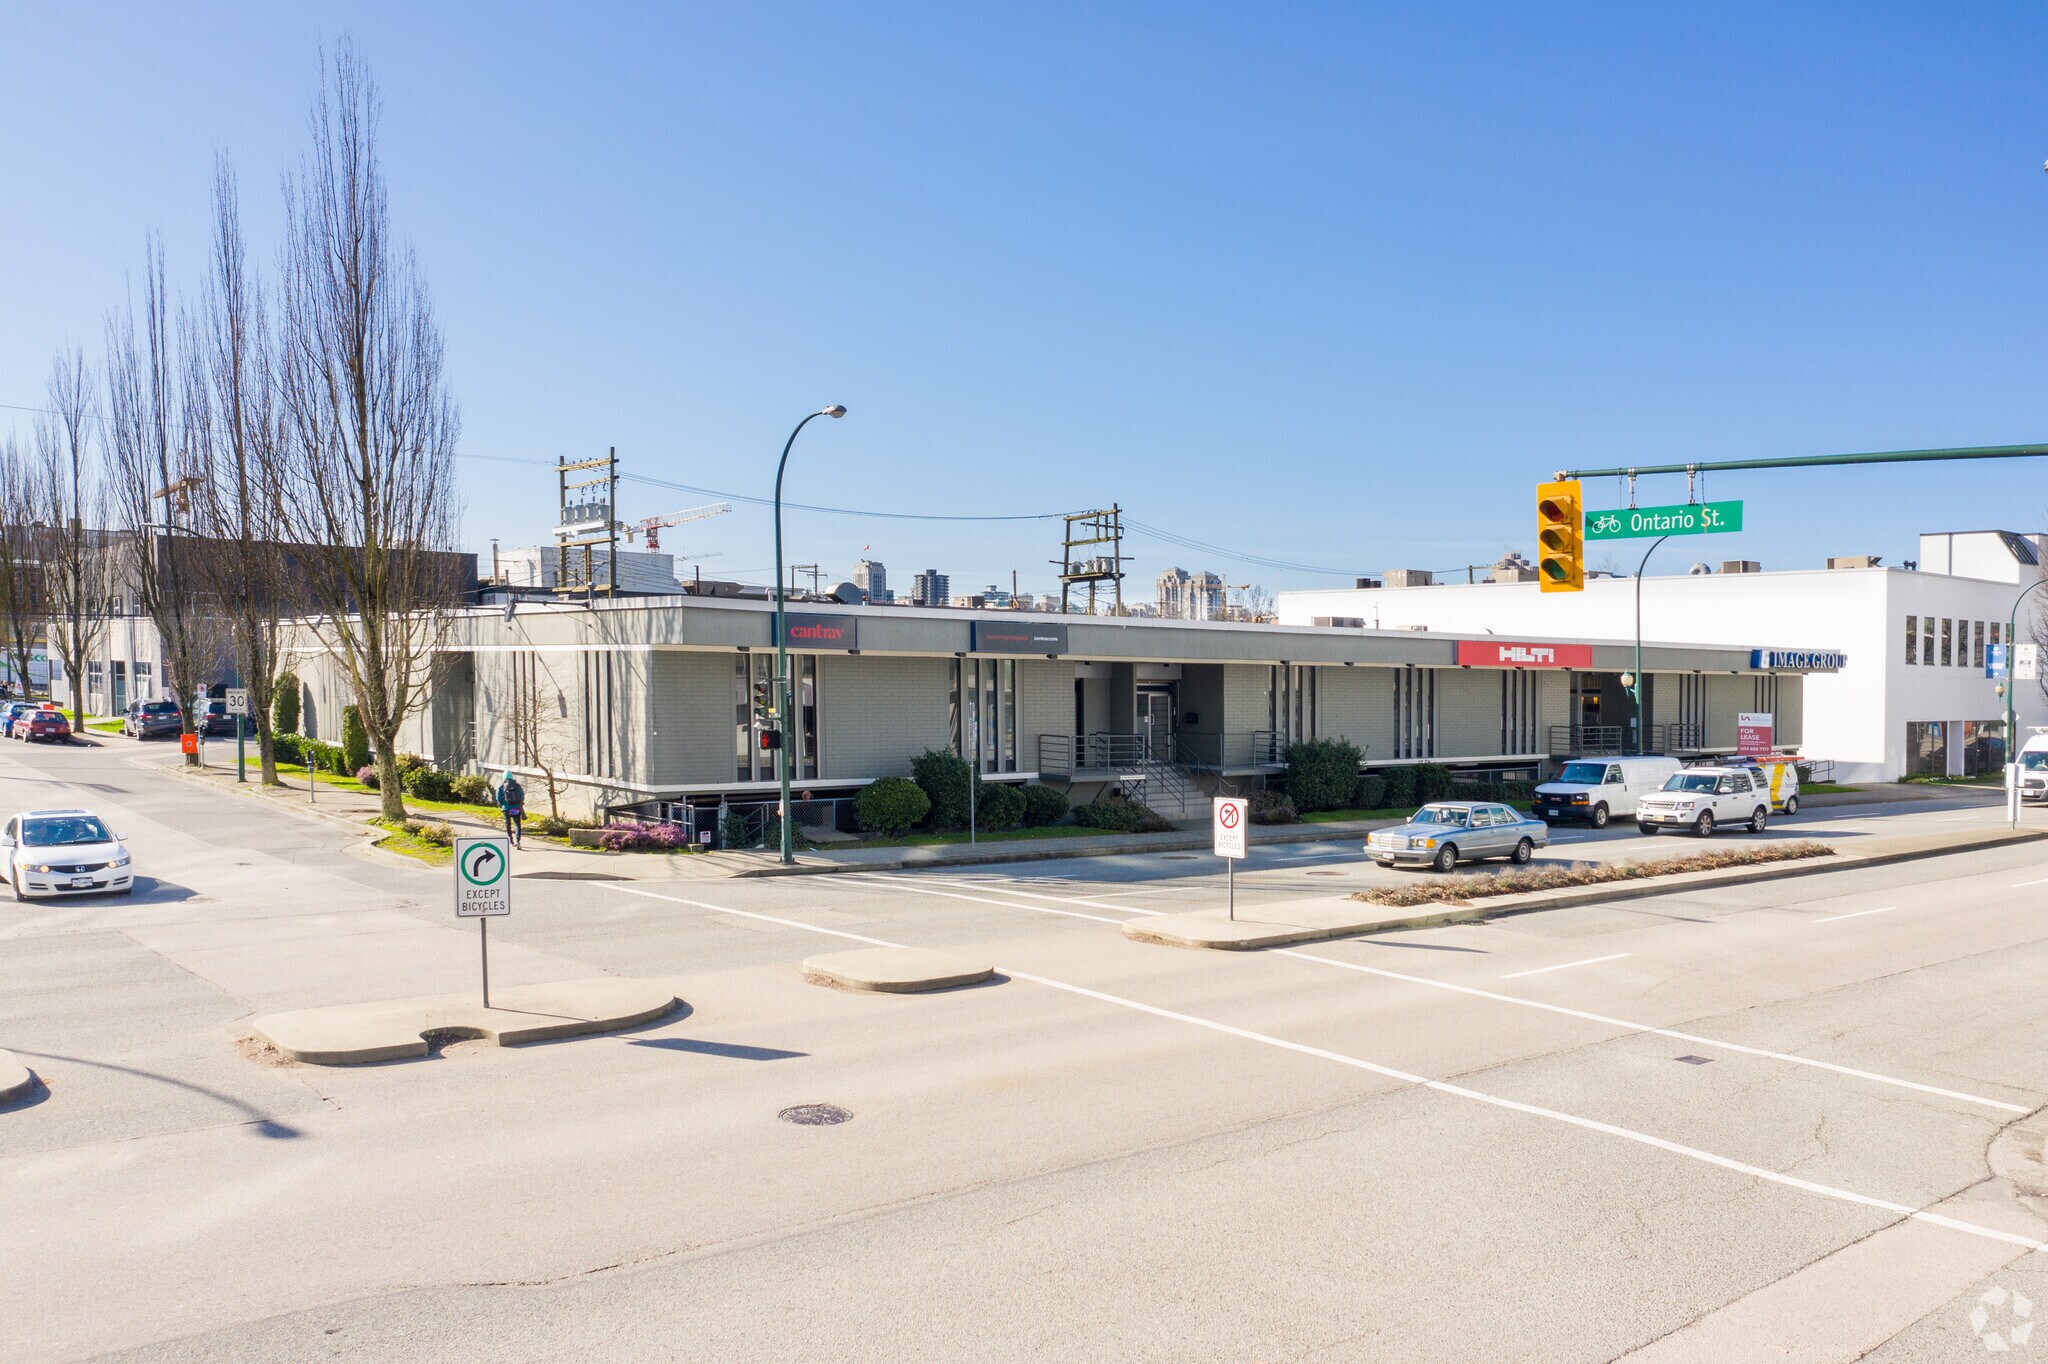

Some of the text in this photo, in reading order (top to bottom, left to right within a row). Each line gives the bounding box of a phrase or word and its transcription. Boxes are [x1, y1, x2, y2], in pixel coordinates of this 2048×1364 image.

[1631, 508, 1725, 531] Ontario St.
[790, 623, 844, 639] cantrav
[1499, 646, 1554, 663] HILTI
[1774, 652, 1810, 669] IMAGE
[1813, 652, 1848, 669] GROUP
[229, 695, 245, 707] 30
[467, 889, 501, 899] EXCEPT
[462, 901, 505, 912] BICYCLES
